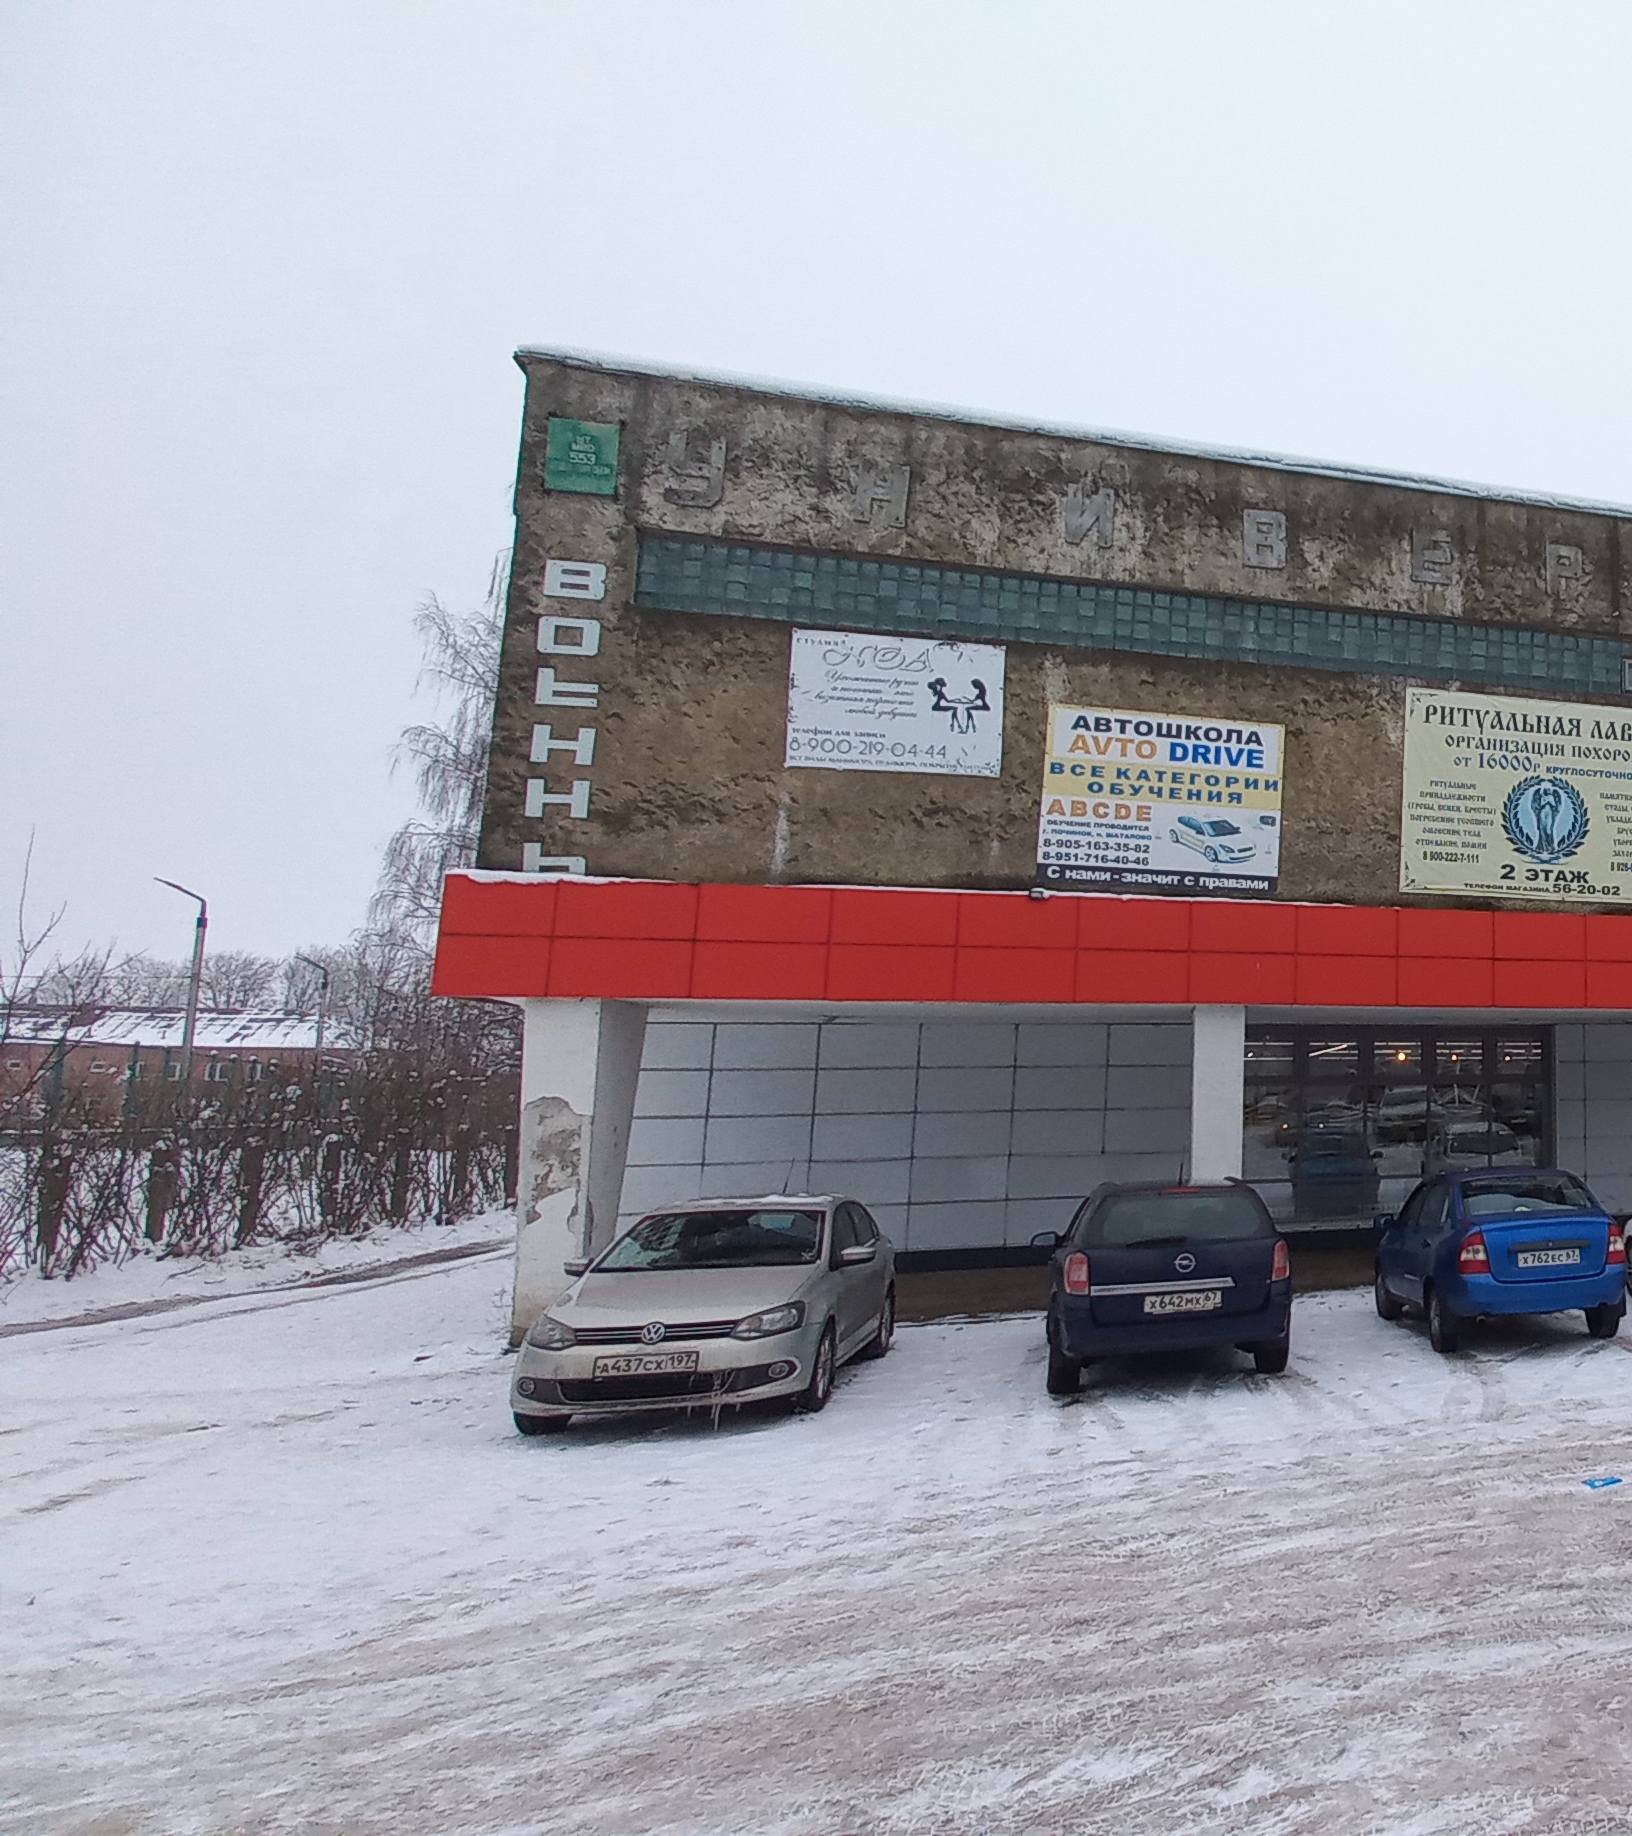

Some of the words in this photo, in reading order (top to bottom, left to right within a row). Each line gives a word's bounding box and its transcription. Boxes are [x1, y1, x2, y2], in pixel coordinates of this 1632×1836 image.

[569, 451, 597, 465] 553
[1070, 715, 1264, 747] АВТОШКОЛА
[1423, 704, 1583, 738] РИТУАЛЬНАЯ
[789, 738, 947, 759] 8-900-219-04-44
[1067, 734, 1158, 759] AVTO
[1169, 742, 1264, 769] DRIVE
[1444, 734, 1566, 758] ОРГАНИЗАЦИЯ
[1049, 762, 1105, 778] ВСЕ
[1116, 767, 1279, 792] КАТЕГОРИИ
[1087, 782, 1243, 805] ОБУЧЕНИЯ
[1046, 799, 1152, 822] ABCDE
[1047, 819, 1091, 828] ОБУЧЕНИЕ
[1093, 822, 1150, 832] ПРОВОДИТСЯ
[1043, 838, 1150, 854] 8-905-163-35-82
[1042, 851, 1149, 866] 8-951-716-40-46
[1047, 865, 1060, 880] С
[1184, 877, 1195, 886] с
[1199, 876, 1269, 891] правами
[1499, 863, 1517, 881] 2
[1524, 866, 1590, 885] ЭТАЖ
[1463, 882, 1503, 891] ТЕЛЕФОН
[1552, 883, 1621, 897] 56-20-02
[1149, 1295, 1202, 1310] Х642МХ
[600, 1358, 664, 1374] А437СХ
[668, 1355, 693, 1367] 197
